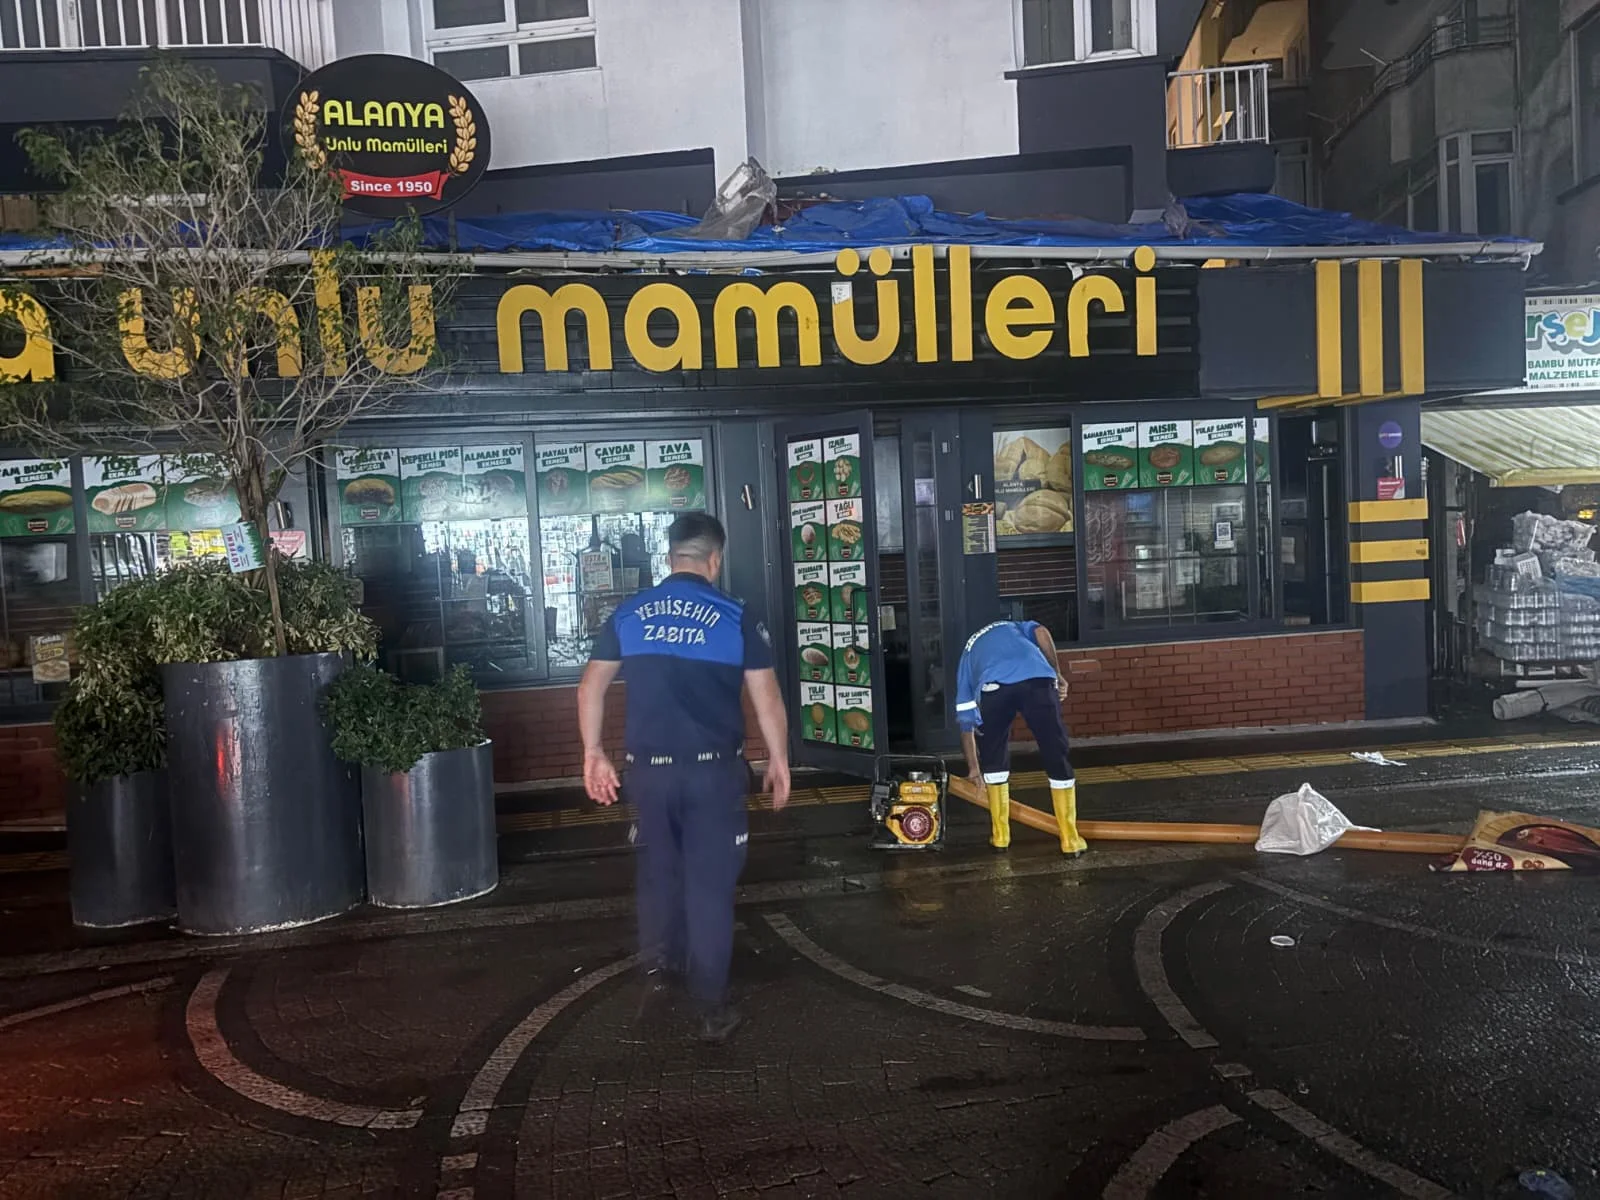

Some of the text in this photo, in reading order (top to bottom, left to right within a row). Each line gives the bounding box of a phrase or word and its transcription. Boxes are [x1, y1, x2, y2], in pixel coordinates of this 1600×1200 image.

[323, 99, 445, 129] ALANYA
[366, 137, 448, 154] Mamülleri
[350, 180, 433, 193] Since 1950
[118, 250, 436, 380] unlu
[496, 244, 1157, 373] mamülleri
[1528, 359, 1565, 369] BAMBU
[464, 450, 500, 462] ALMAN
[594, 443, 636, 459] ÇAVDAR
[659, 442, 691, 454] TAVA
[643, 624, 707, 645] ZABITA
